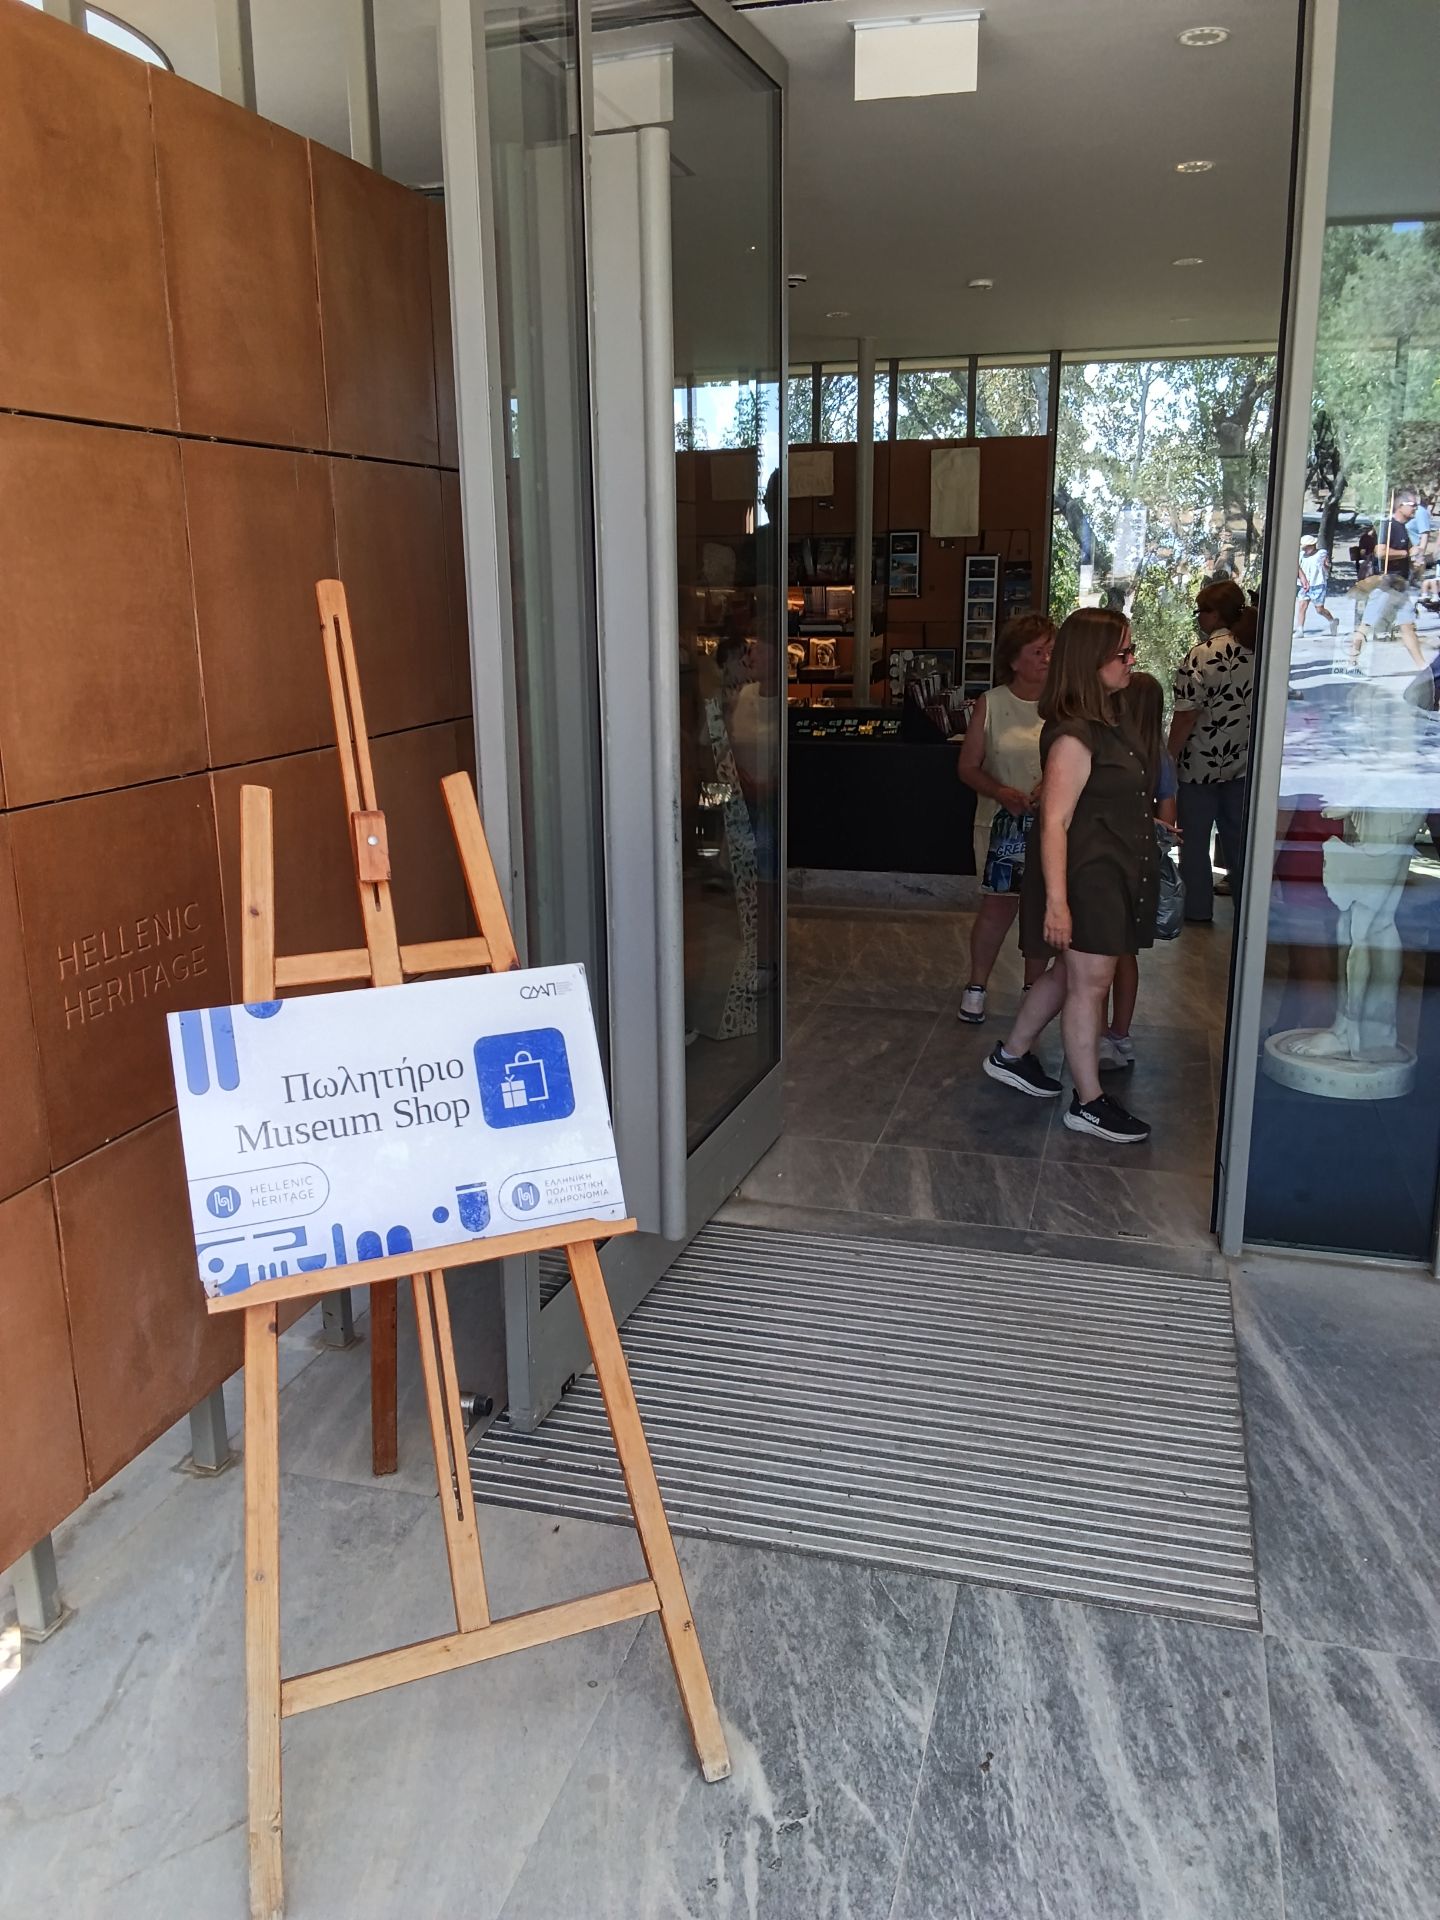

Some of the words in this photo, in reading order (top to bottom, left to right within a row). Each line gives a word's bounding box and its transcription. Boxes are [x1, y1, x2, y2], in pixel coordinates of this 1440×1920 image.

[57, 902, 201, 981] HELLENIC
[64, 945, 208, 1030] HERITAGE
[281, 1056, 465, 1104] Πωλητήριο
[234, 1111, 384, 1154] Museum
[393, 1096, 470, 1129] Shop
[249, 1175, 313, 1194] HELLENIC
[544, 1172, 592, 1188] ΕΛΛΗΝΙΚΗ
[545, 1180, 604, 1197] ΠΟΛΙΤΙΣΤΙΚΗ
[251, 1188, 316, 1208] HERITAGE
